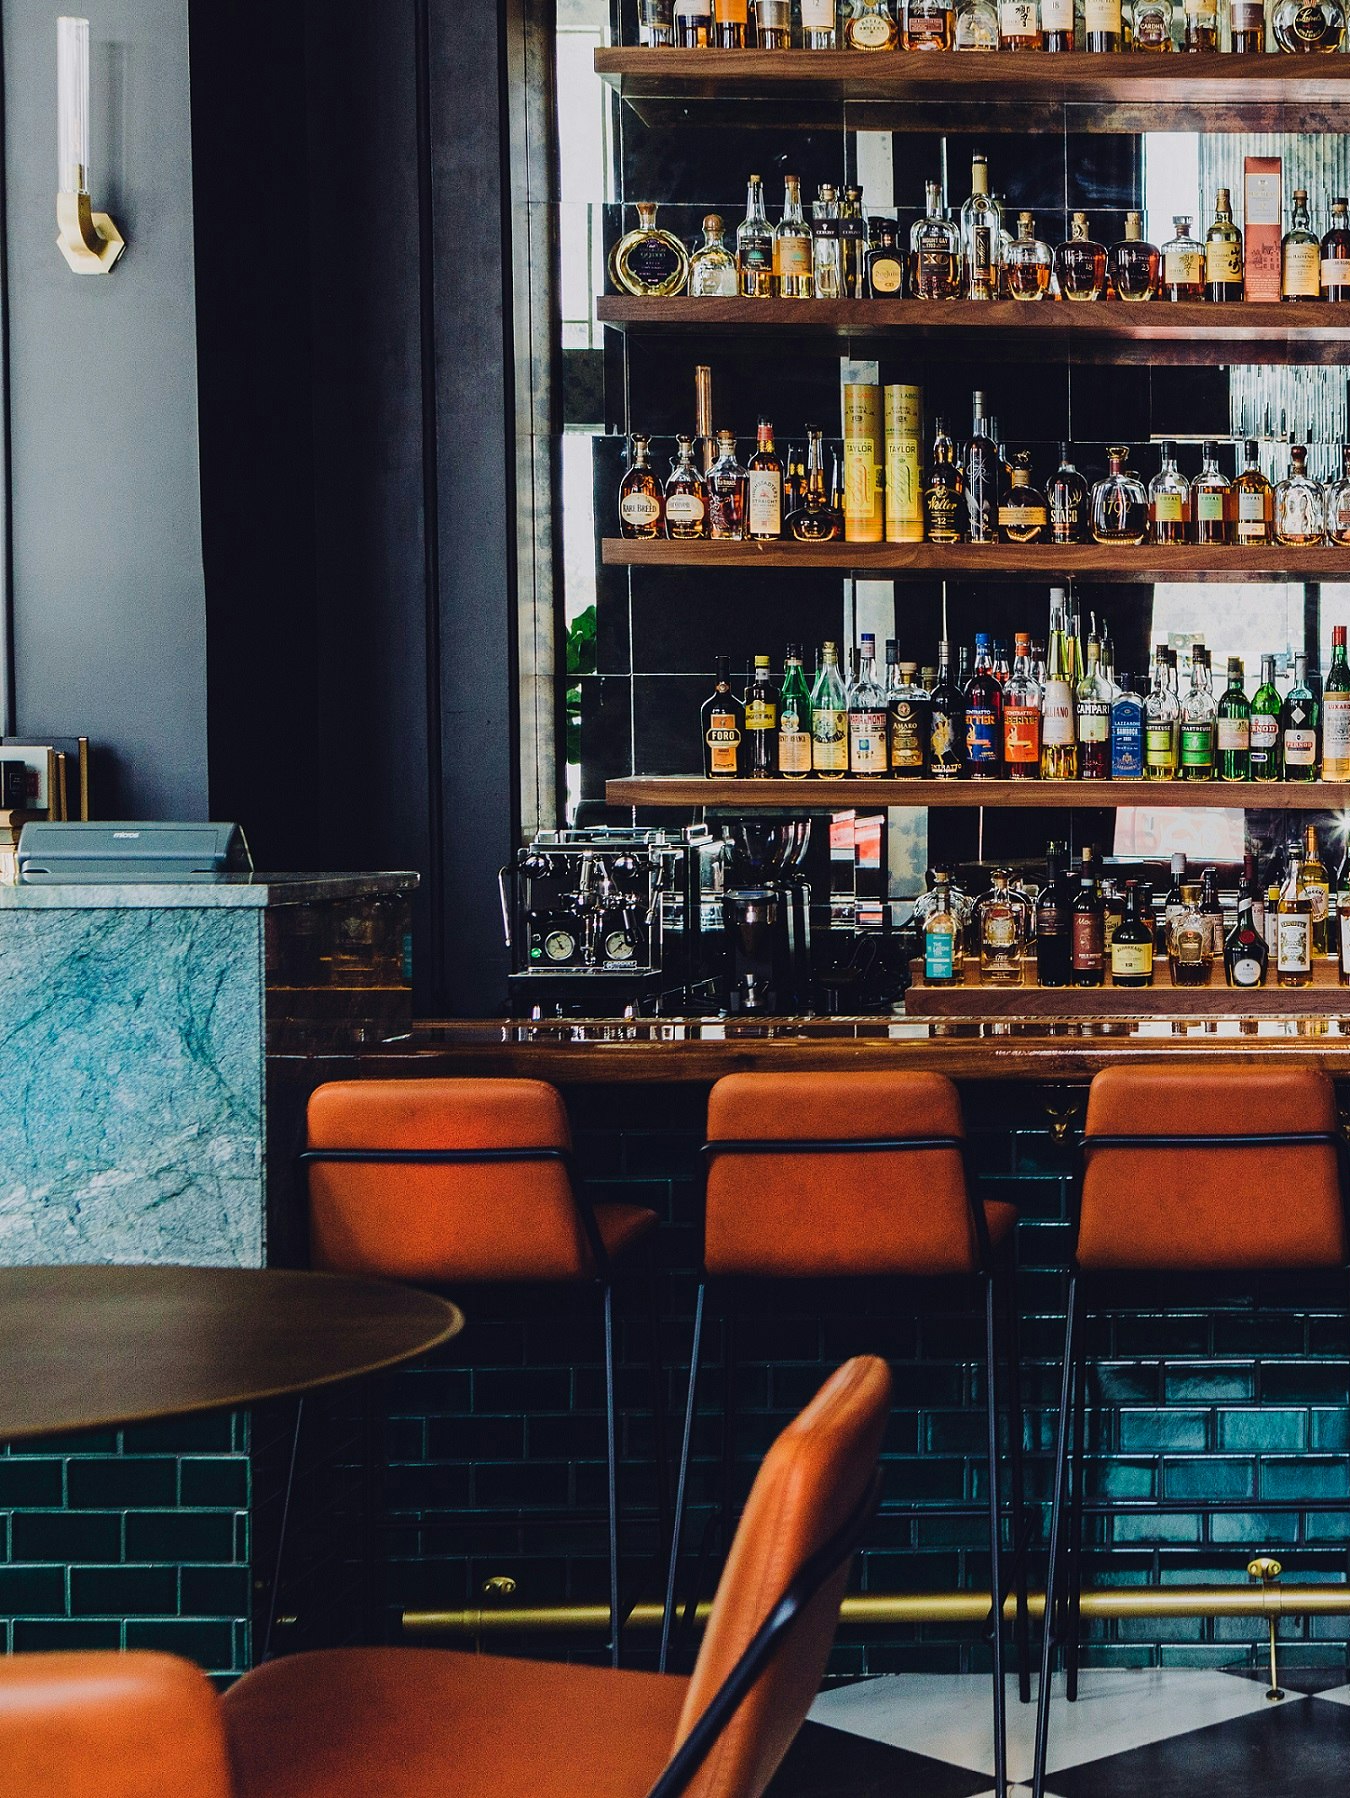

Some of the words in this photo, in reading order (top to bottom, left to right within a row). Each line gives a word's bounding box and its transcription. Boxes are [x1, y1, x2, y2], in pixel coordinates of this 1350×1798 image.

[923, 253, 949, 265] XO
[847, 445, 873, 453] TAYLOR
[889, 446, 916, 454] TAYLOR
[623, 504, 636, 513] RARE
[638, 503, 657, 513] BREED
[1103, 500, 1131, 519] 1792
[1077, 703, 1109, 714] CAMPARI
[711, 731, 735, 741] FORO
